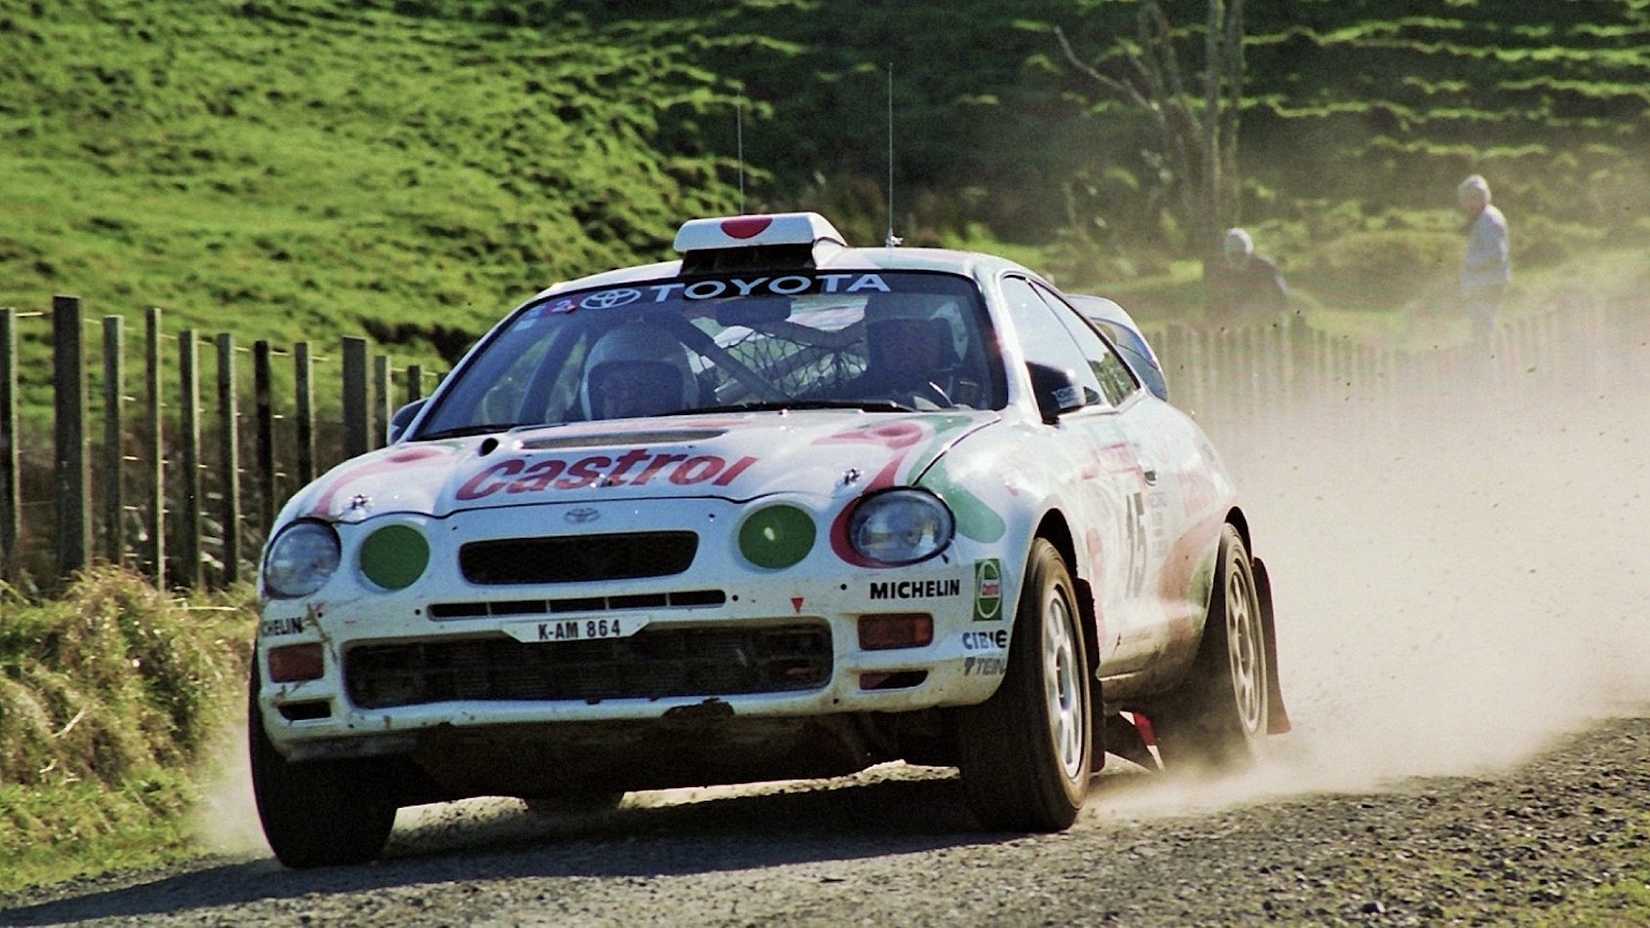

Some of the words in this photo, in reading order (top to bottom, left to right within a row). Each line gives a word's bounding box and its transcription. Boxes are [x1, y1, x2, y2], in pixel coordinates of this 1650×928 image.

[650, 274, 891, 303] TOYOTA
[455, 448, 758, 501] Castrol
[870, 579, 961, 600] MICHELIN
[538, 621, 579, 640] K-AM
[586, 619, 621, 638] 864
[962, 630, 1007, 650] CIBIE
